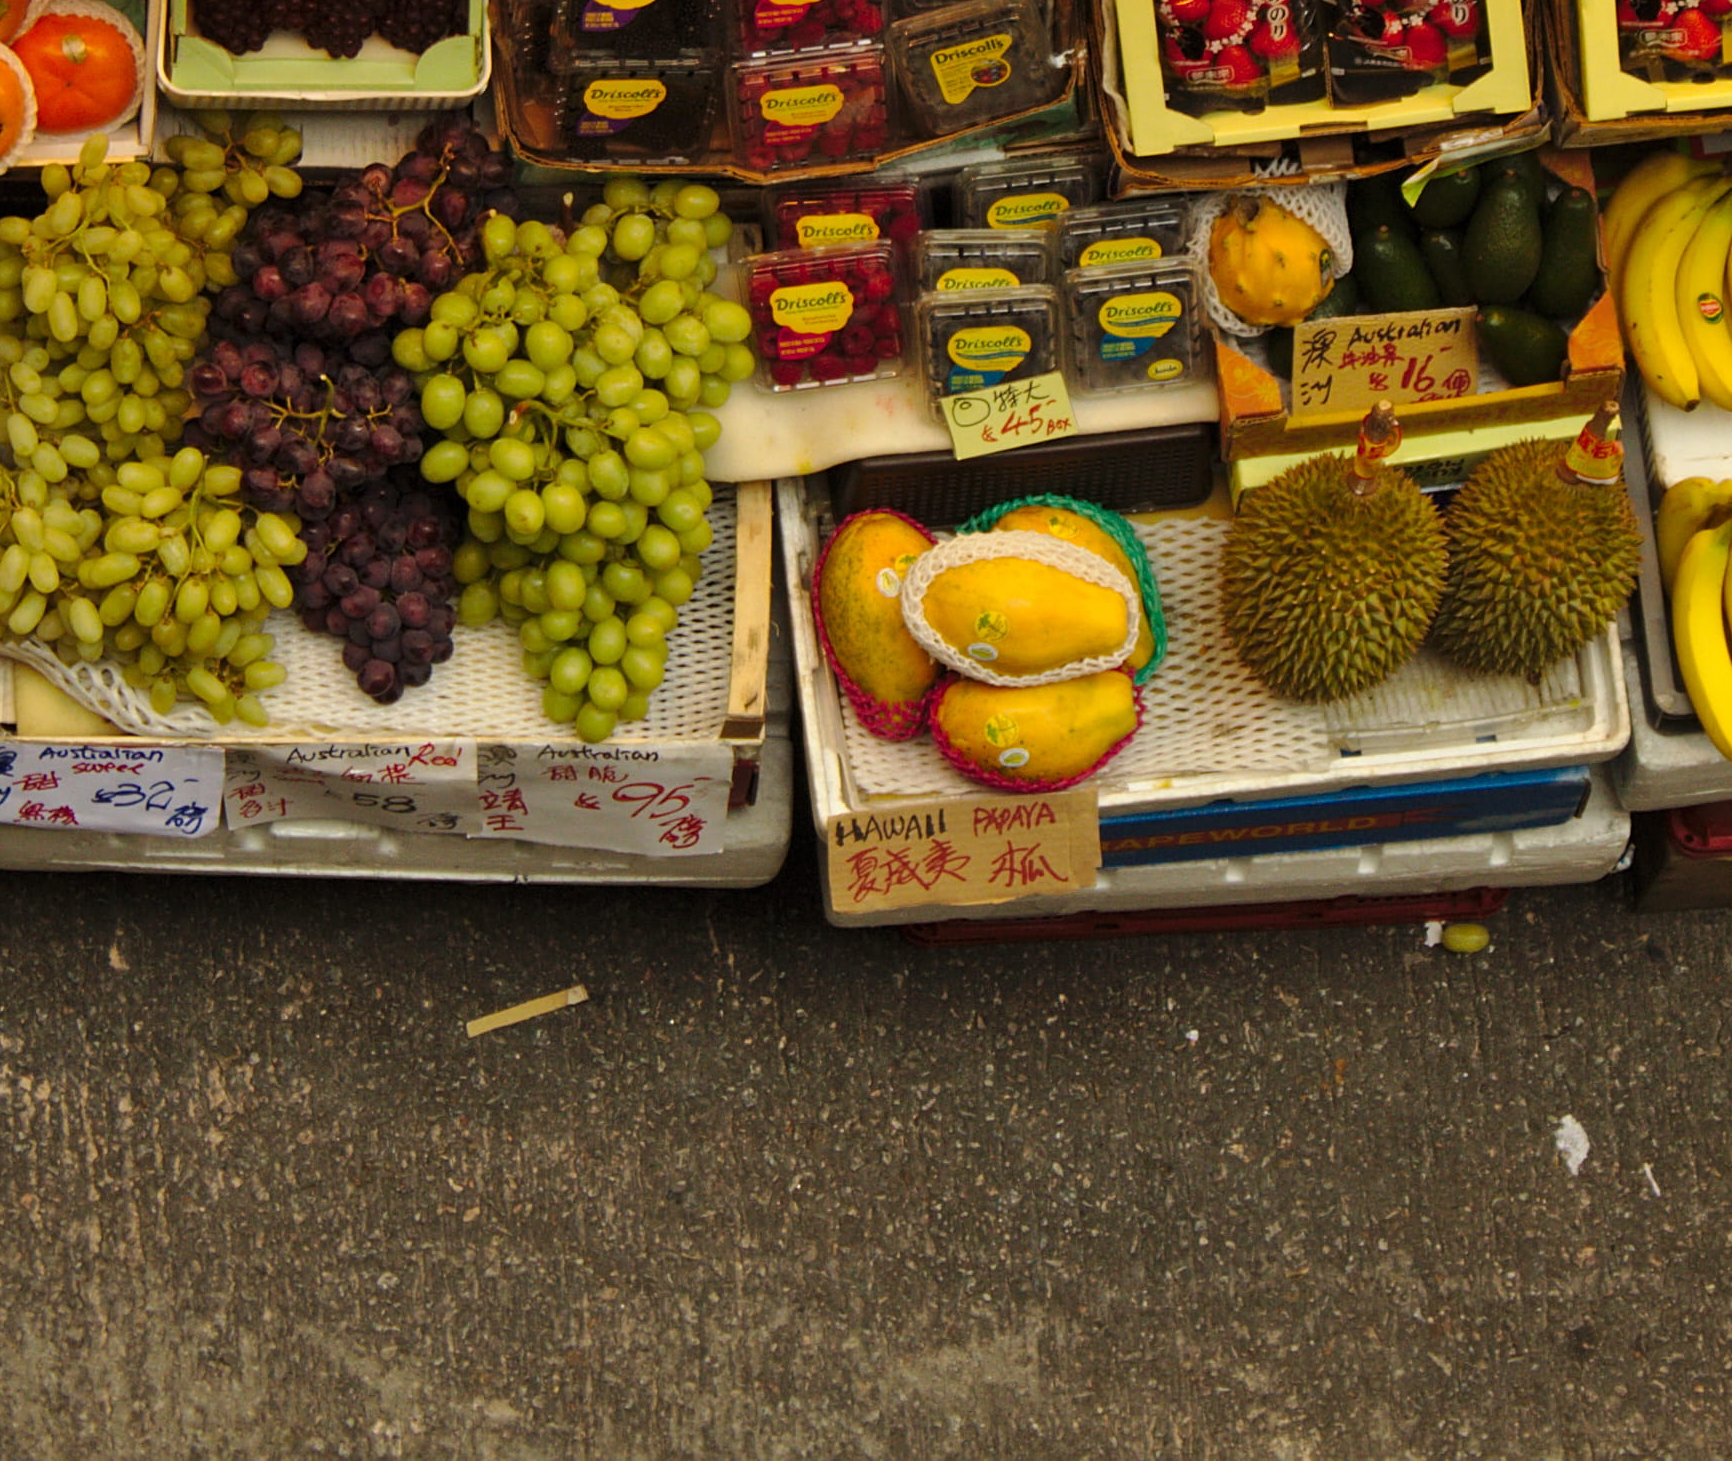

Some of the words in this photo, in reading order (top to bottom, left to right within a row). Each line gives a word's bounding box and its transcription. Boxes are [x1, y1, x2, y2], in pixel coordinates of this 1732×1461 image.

[935, 37, 1004, 66] Driscoll's
[590, 88, 662, 101] Driscoll's
[765, 91, 838, 110] Driscoll's
[995, 200, 1064, 218] Driscoll's
[802, 223, 875, 240] Driscoll's
[1088, 244, 1156, 263] Driscoll's
[775, 290, 848, 312] Driscoll's
[1106, 300, 1173, 320] Driscoll's
[954, 334, 1023, 351] Driscoll's
[993, 381, 1050, 412] 特大
[38, 745, 164, 765] Australian
[285, 744, 411, 764] Australian
[537, 744, 660, 762] Australian
[1104, 815, 1380, 852] APEWORLD
